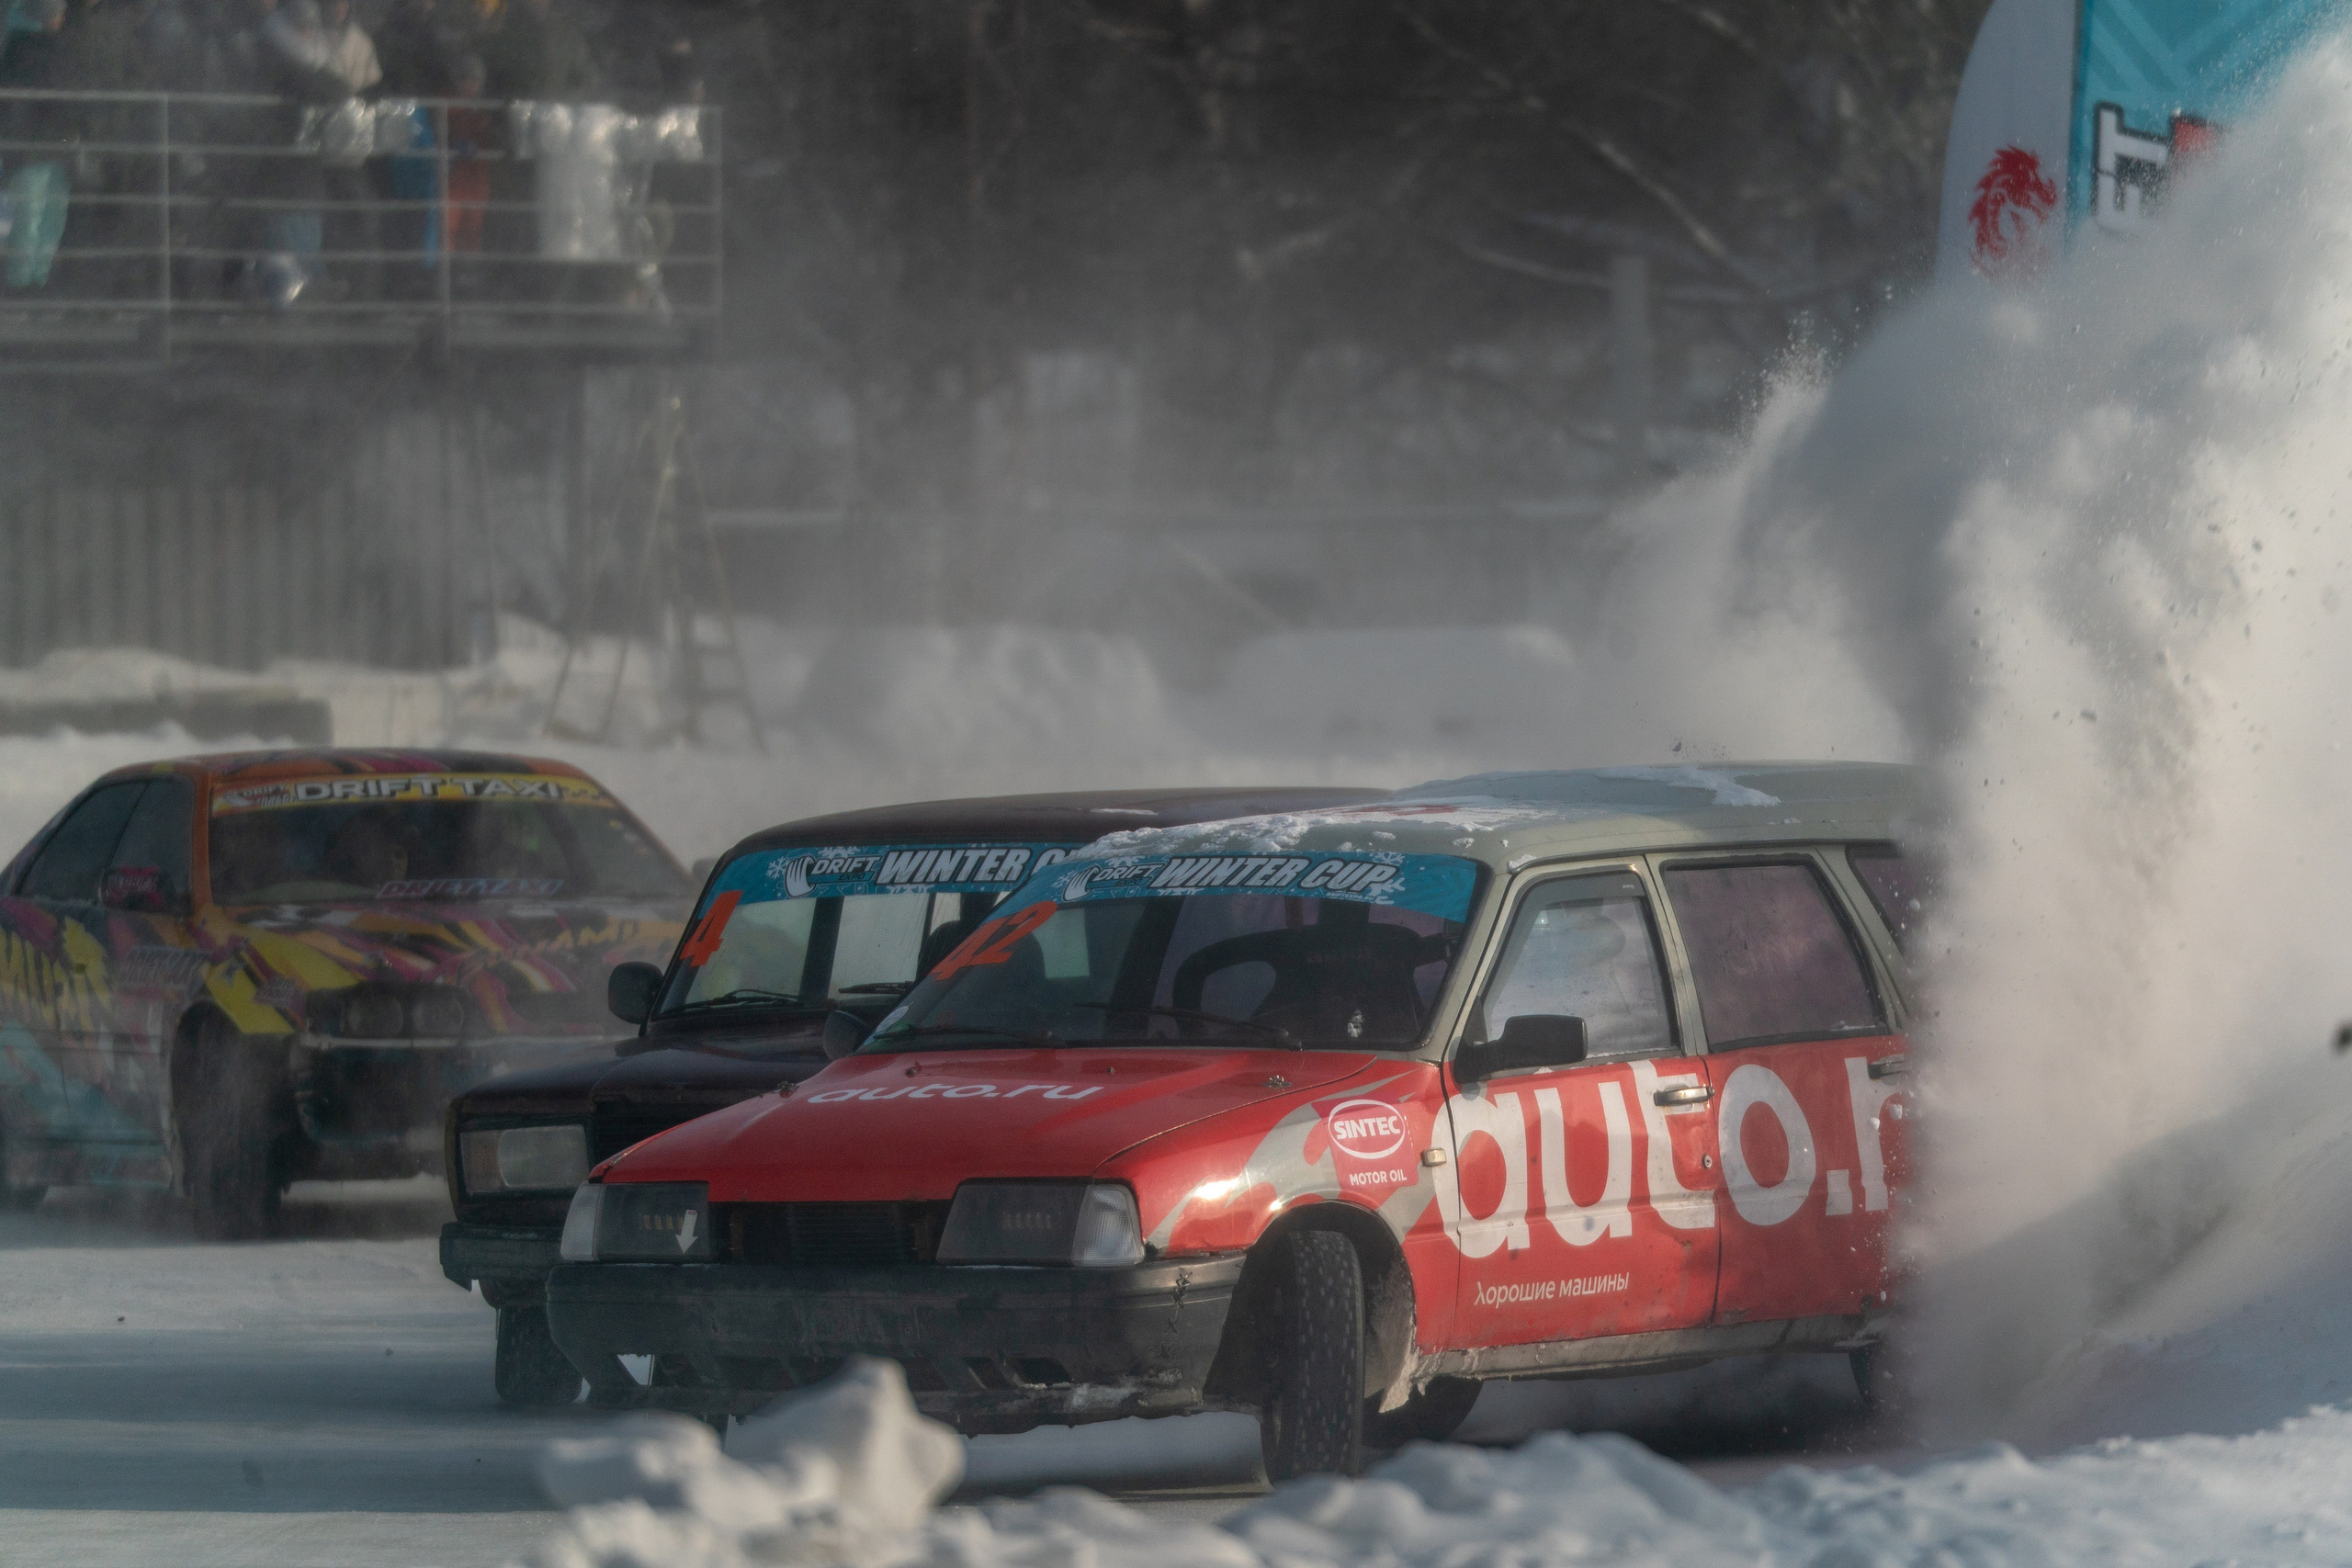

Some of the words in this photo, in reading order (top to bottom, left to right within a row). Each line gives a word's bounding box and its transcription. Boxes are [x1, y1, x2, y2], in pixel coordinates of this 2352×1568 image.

[295, 777, 442, 800] DRIFT
[449, 778, 560, 797] TAXI
[811, 855, 882, 874] DRIFT
[838, 872, 865, 881] EXPO
[875, 848, 1031, 886] WINTER
[1091, 863, 1163, 882] DRIFT
[1149, 857, 1310, 887] WINTER
[1300, 860, 1397, 892] CUP
[679, 890, 743, 967] 4
[927, 901, 1058, 981] 42
[808, 1083, 1104, 1103] auto.ru
[1333, 1115, 1401, 1140] SINTEC
[1431, 1056, 1909, 1258] auto.r
[1349, 1170, 1388, 1186] MOTOR
[1389, 1168, 1408, 1182] OIL
[1558, 1271, 1630, 1298] машины
